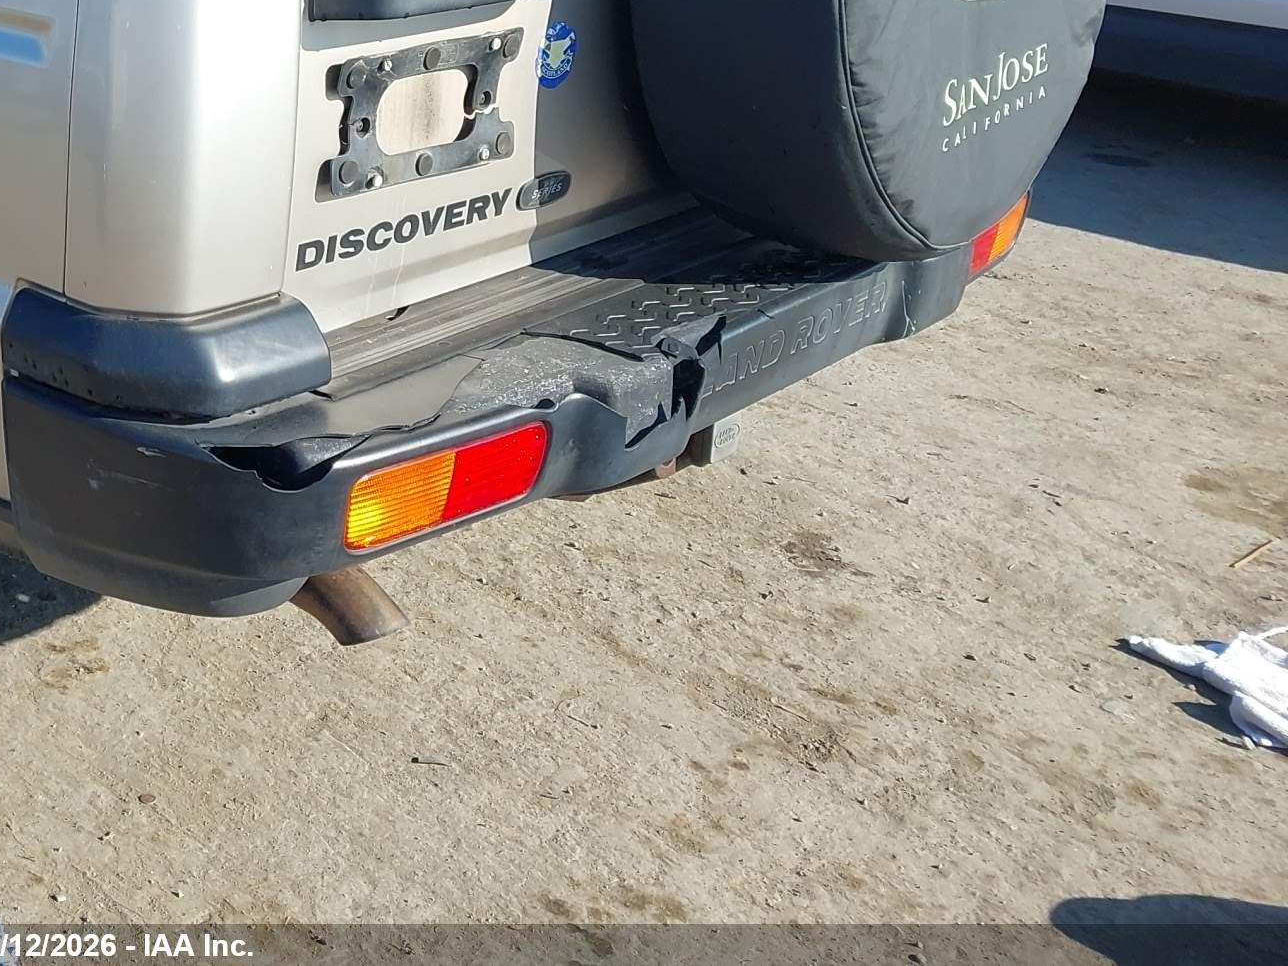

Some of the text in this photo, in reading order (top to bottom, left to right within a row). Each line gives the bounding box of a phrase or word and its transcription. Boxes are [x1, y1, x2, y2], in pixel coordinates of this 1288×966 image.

[942, 85, 1046, 153] CALIFORNIA
[532, 182, 563, 199] SERIES
[295, 188, 512, 272] DISCOVERY
